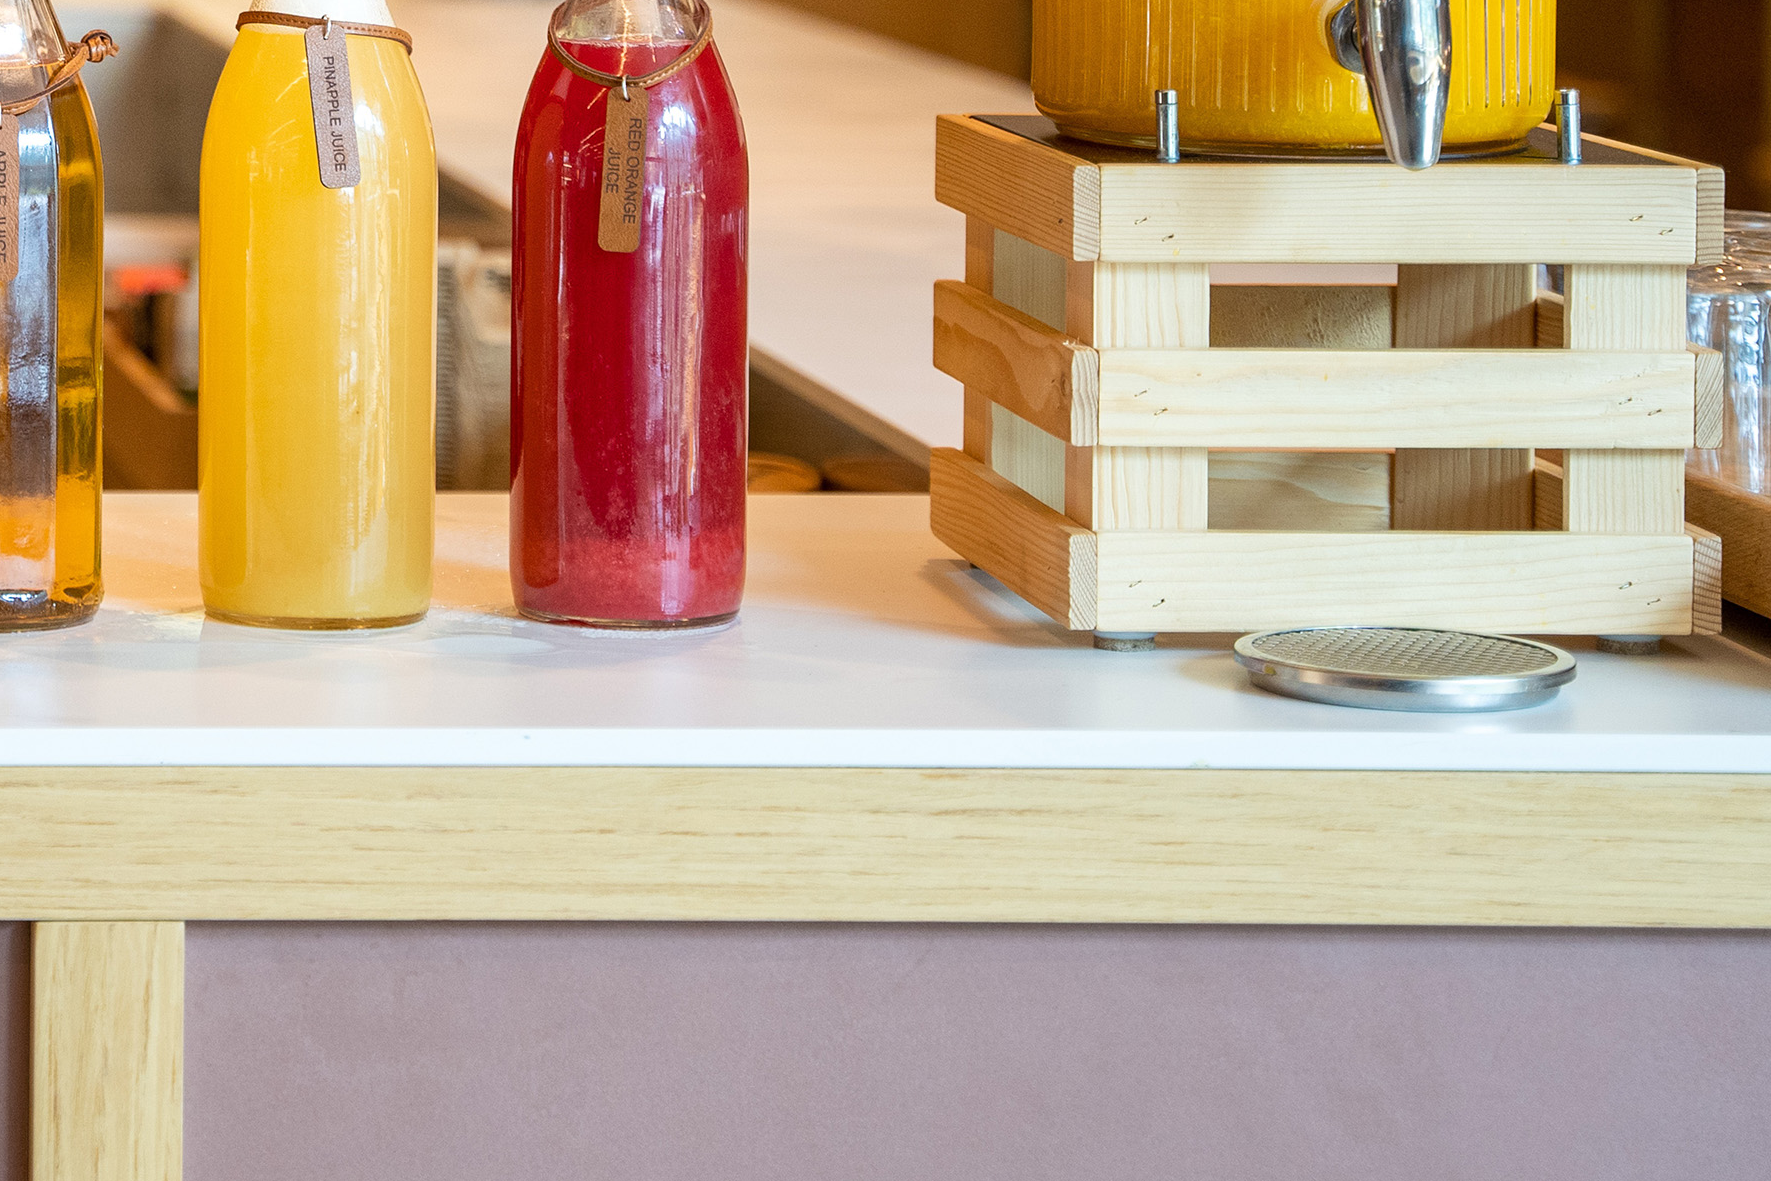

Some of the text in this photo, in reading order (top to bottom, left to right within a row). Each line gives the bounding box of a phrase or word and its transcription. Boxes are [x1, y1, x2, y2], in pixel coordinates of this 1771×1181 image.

[323, 55, 347, 173] PINAPPLE JUICE
[605, 147, 621, 194] JUICE
[622, 117, 643, 225] RED ORANGE
